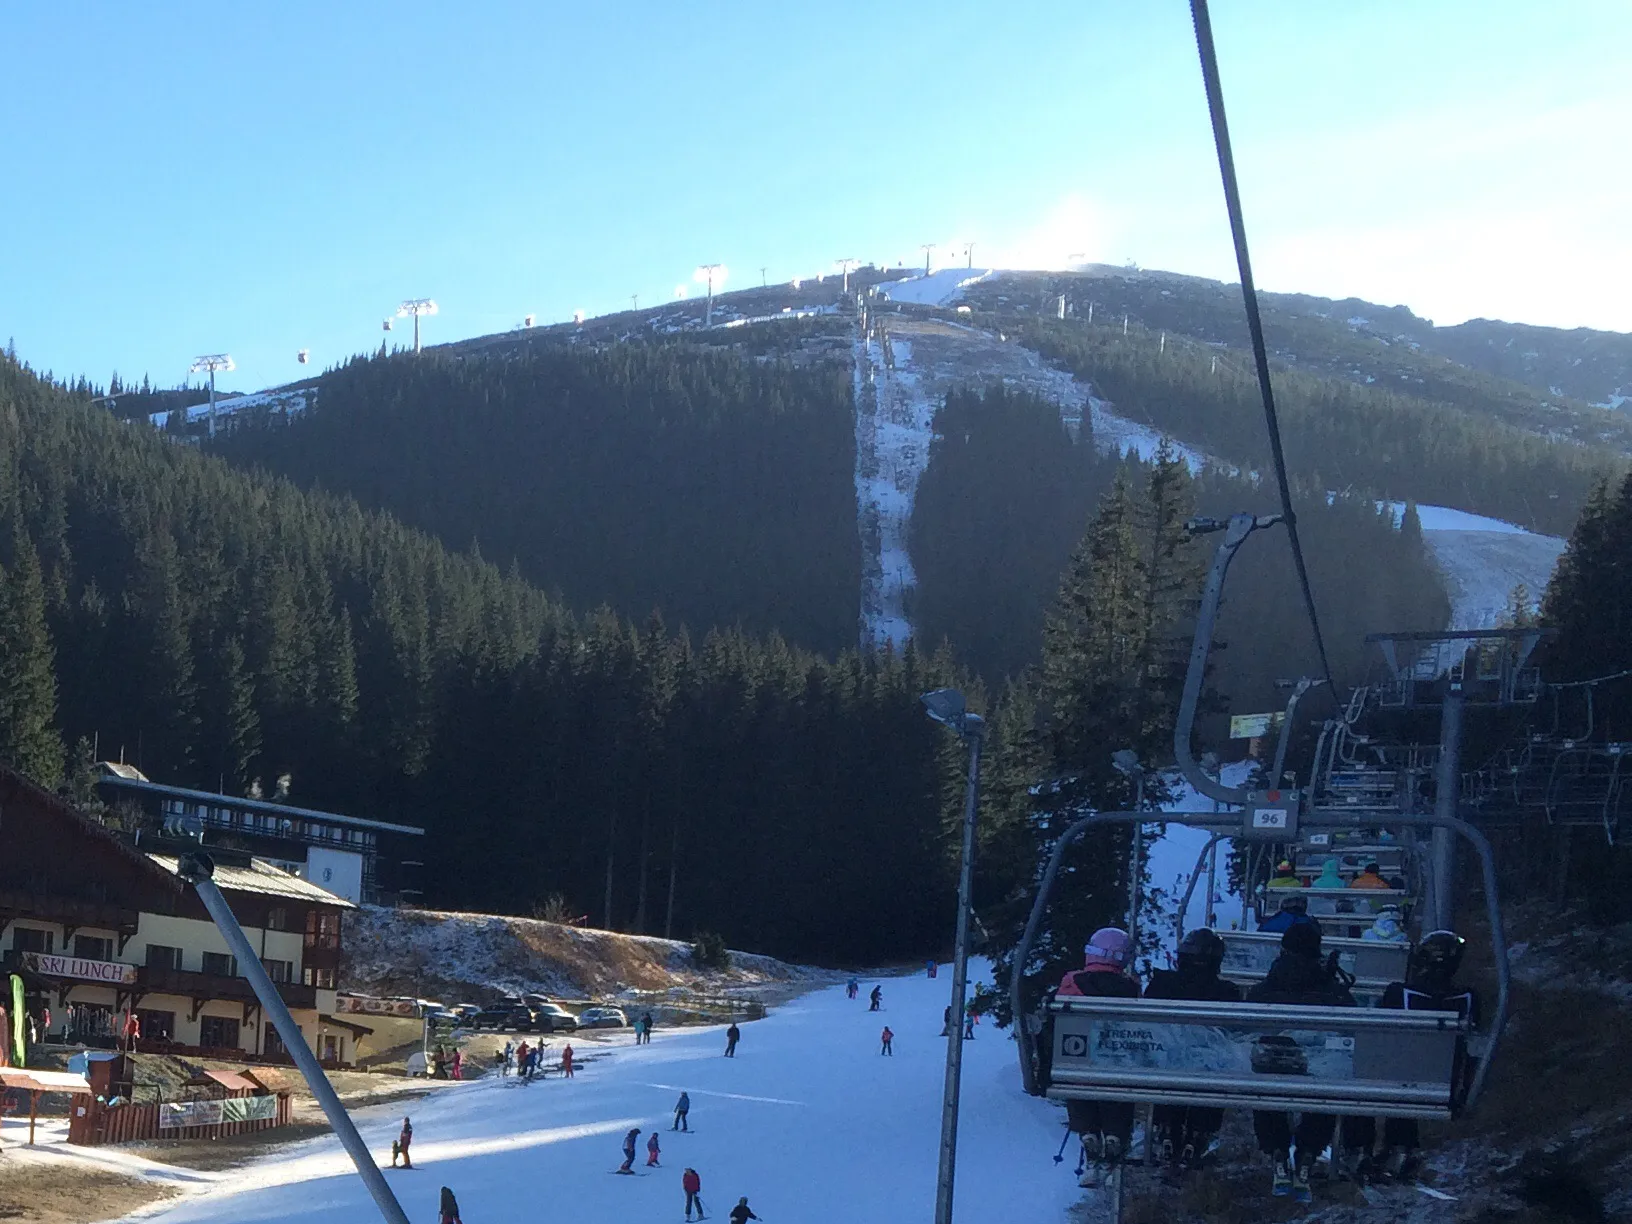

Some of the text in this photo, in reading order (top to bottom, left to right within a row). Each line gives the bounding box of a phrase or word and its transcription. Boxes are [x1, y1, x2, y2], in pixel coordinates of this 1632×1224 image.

[1261, 813, 1279, 824] 96
[41, 956, 123, 980] SKI LUNCH
